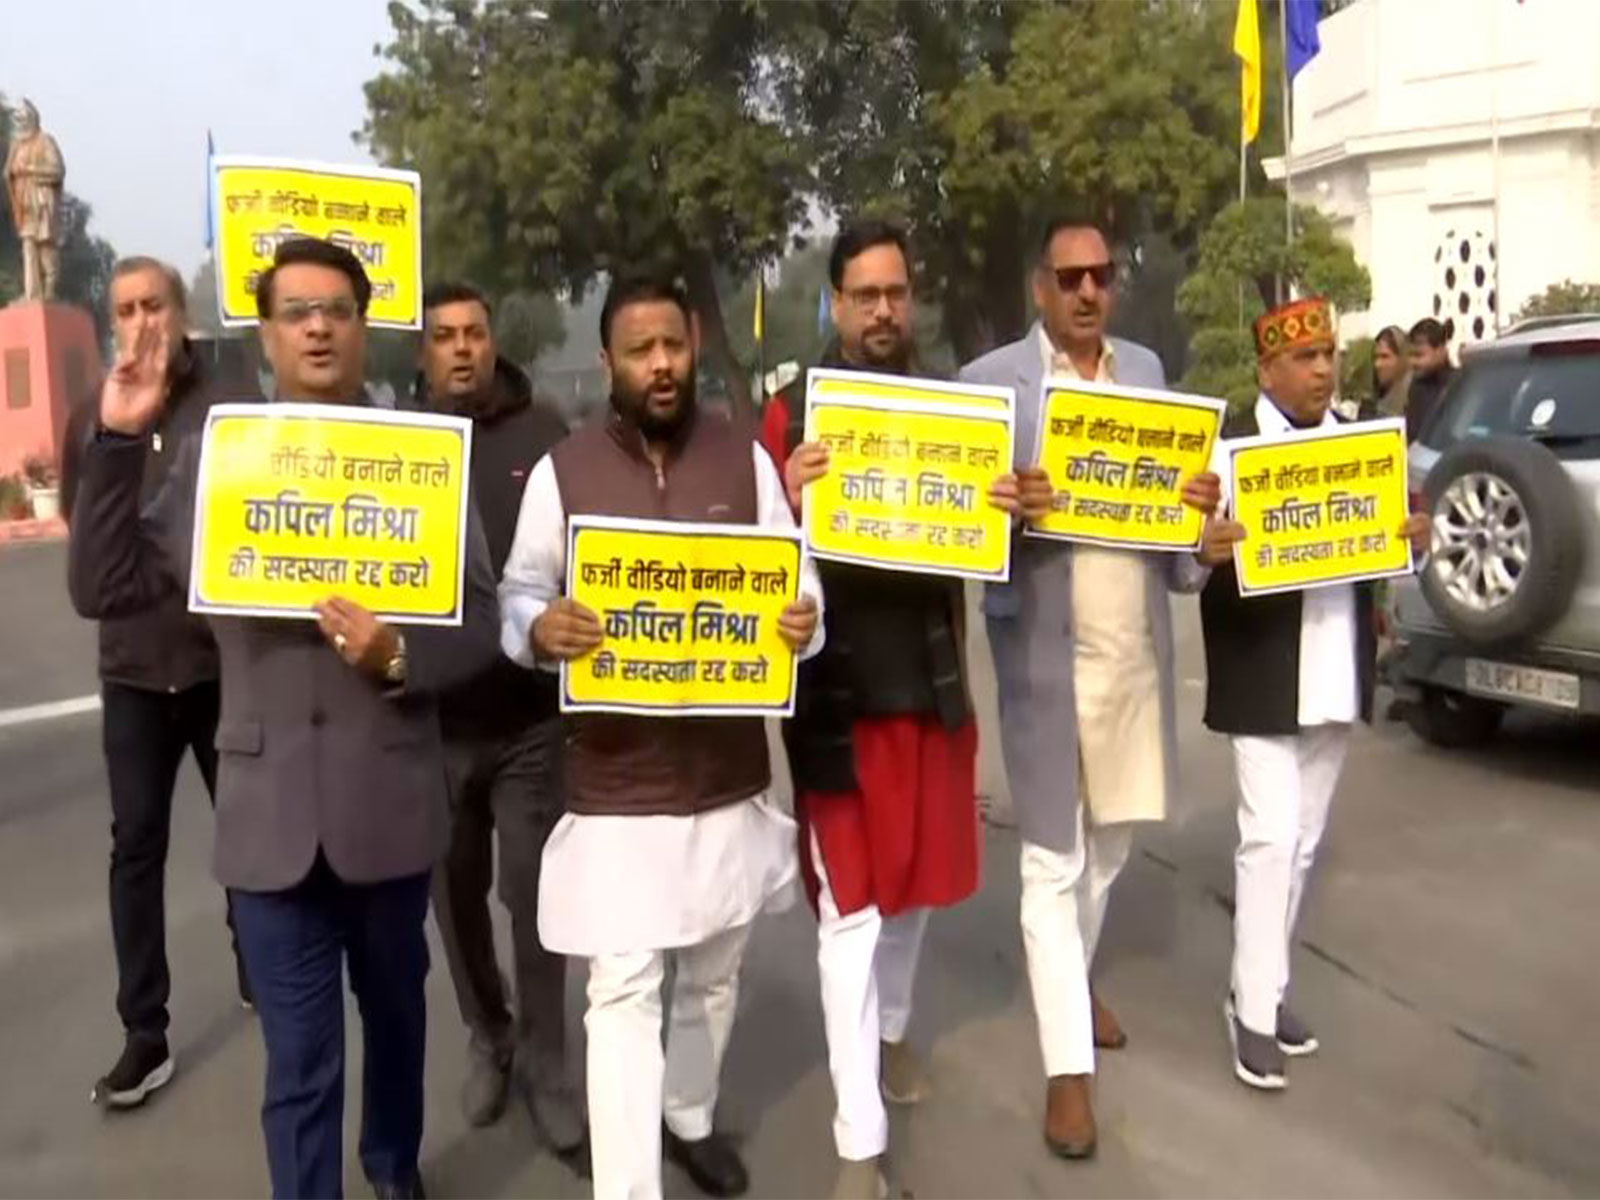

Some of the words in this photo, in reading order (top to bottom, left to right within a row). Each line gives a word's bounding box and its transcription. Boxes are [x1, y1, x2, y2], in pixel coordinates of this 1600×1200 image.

[342, 453, 403, 483] बनाने
[409, 457, 451, 487] वाले
[1066, 451, 1129, 489] कपिल
[1132, 456, 1180, 491] मिश्रा
[916, 471, 975, 512] मिश्रा
[243, 489, 334, 538] कपिल
[341, 493, 419, 543] मिश्रा
[1156, 504, 1184, 525] करो
[1261, 496, 1322, 534] कपिल
[1326, 491, 1377, 526] मिश्रा
[228, 546, 255, 578] की
[262, 555, 348, 584] सदस्यता
[354, 560, 384, 588] रद्द
[388, 556, 429, 588] करो
[1256, 543, 1273, 568] की
[1360, 529, 1386, 554] करो
[626, 559, 686, 593] वीडियो
[691, 562, 745, 593] बनाने
[750, 566, 788, 595] वाले
[604, 600, 685, 644] कपिल
[691, 601, 759, 645] मिश्रा
[592, 651, 616, 681] की
[621, 658, 696, 683] सदस्यता
[732, 654, 769, 684] करो
